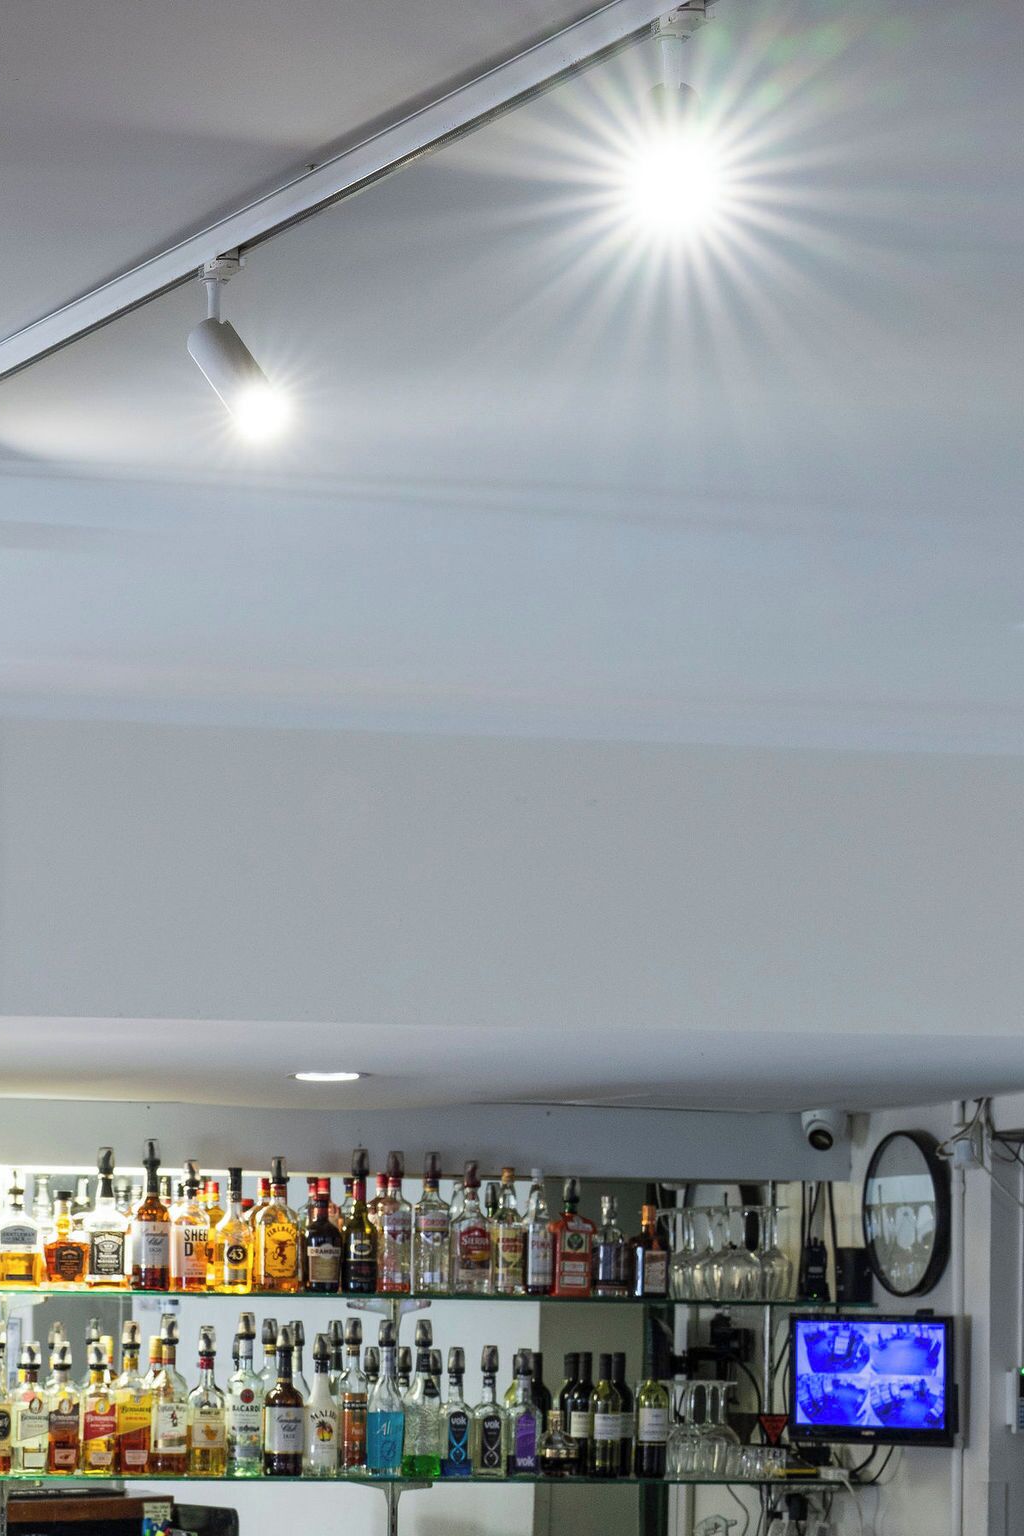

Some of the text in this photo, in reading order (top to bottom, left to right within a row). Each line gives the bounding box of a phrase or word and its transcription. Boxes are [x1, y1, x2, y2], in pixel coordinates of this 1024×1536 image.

[184, 1229, 209, 1242] SHEE
[229, 1249, 244, 1259] 43
[232, 1404, 261, 1413] BACARDI
[451, 1417, 467, 1426] vok
[484, 1420, 500, 1429] vok
[516, 1457, 534, 1467] vok
